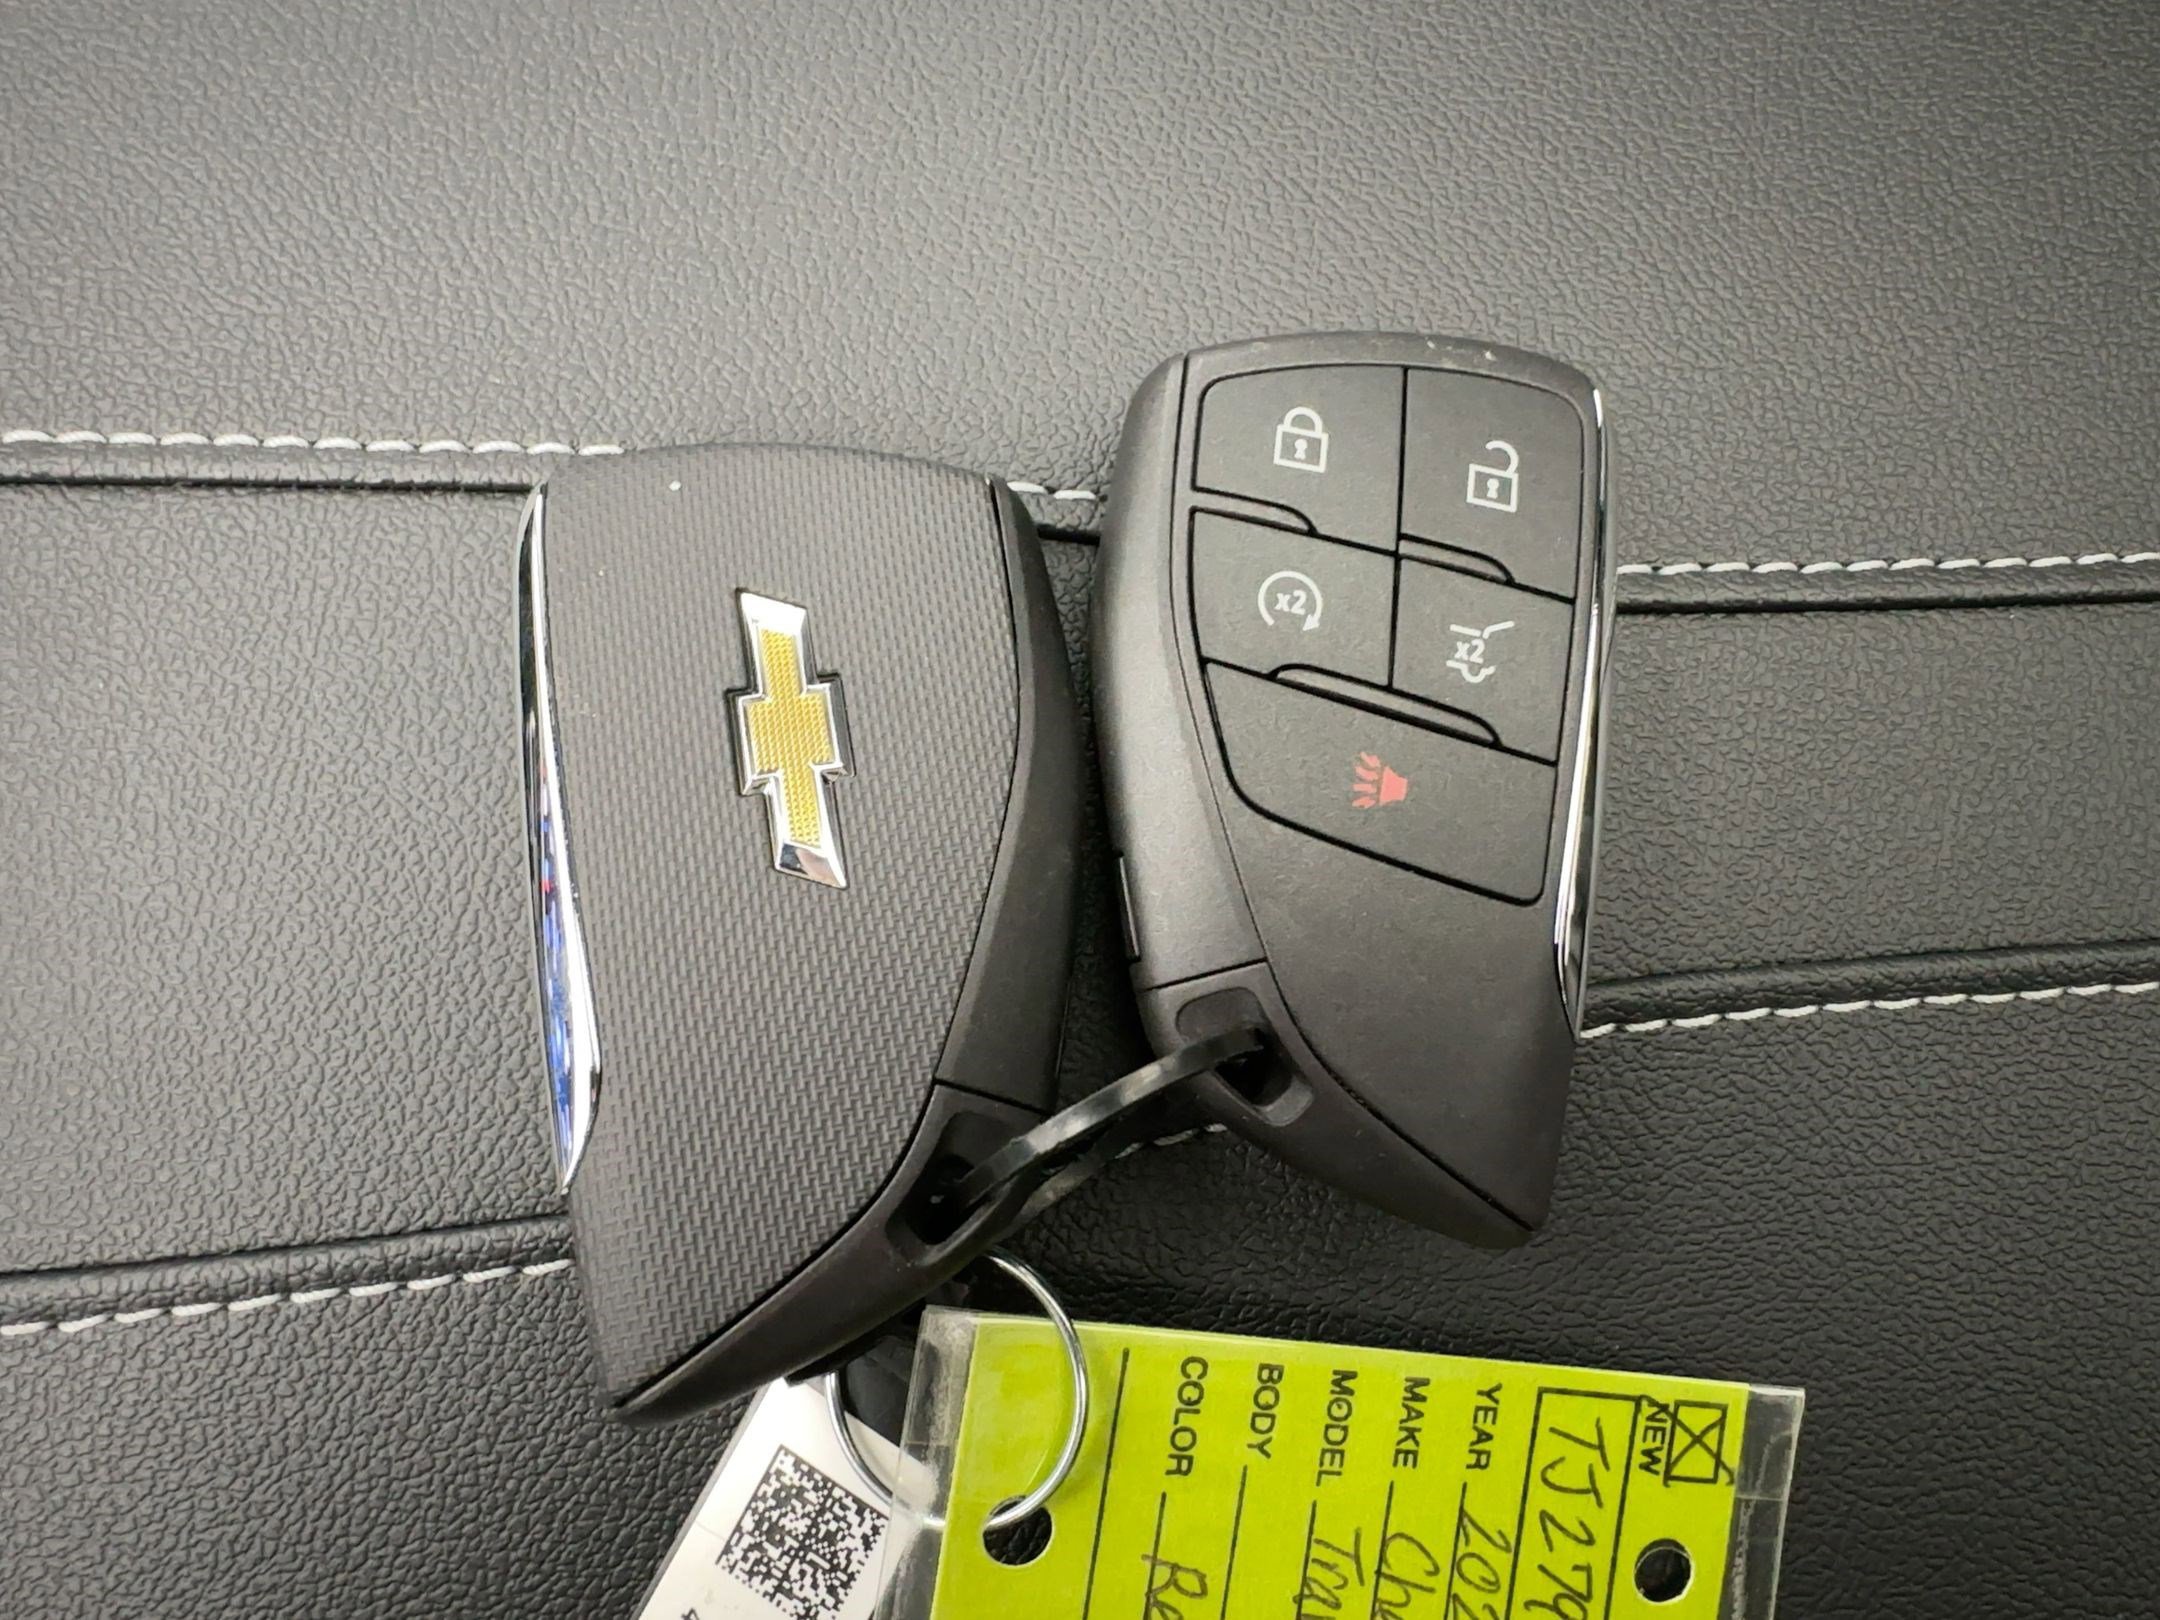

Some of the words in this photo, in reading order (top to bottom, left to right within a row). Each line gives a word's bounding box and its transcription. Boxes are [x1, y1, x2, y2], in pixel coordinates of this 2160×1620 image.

[1274, 590, 1308, 616] x2
[1453, 638, 1487, 664] x2
[1164, 1355, 1209, 1477] COLOR
[1247, 1362, 1285, 1460] BODY
[1315, 1369, 1358, 1487] MODEL
[1392, 1376, 1431, 1470] MAKE
[1465, 1382, 1503, 1471] YEAR
[1637, 1401, 1670, 1476] NEW
[1524, 1416, 1610, 1620] TJ279
[1292, 1527, 1365, 1620] Tra
